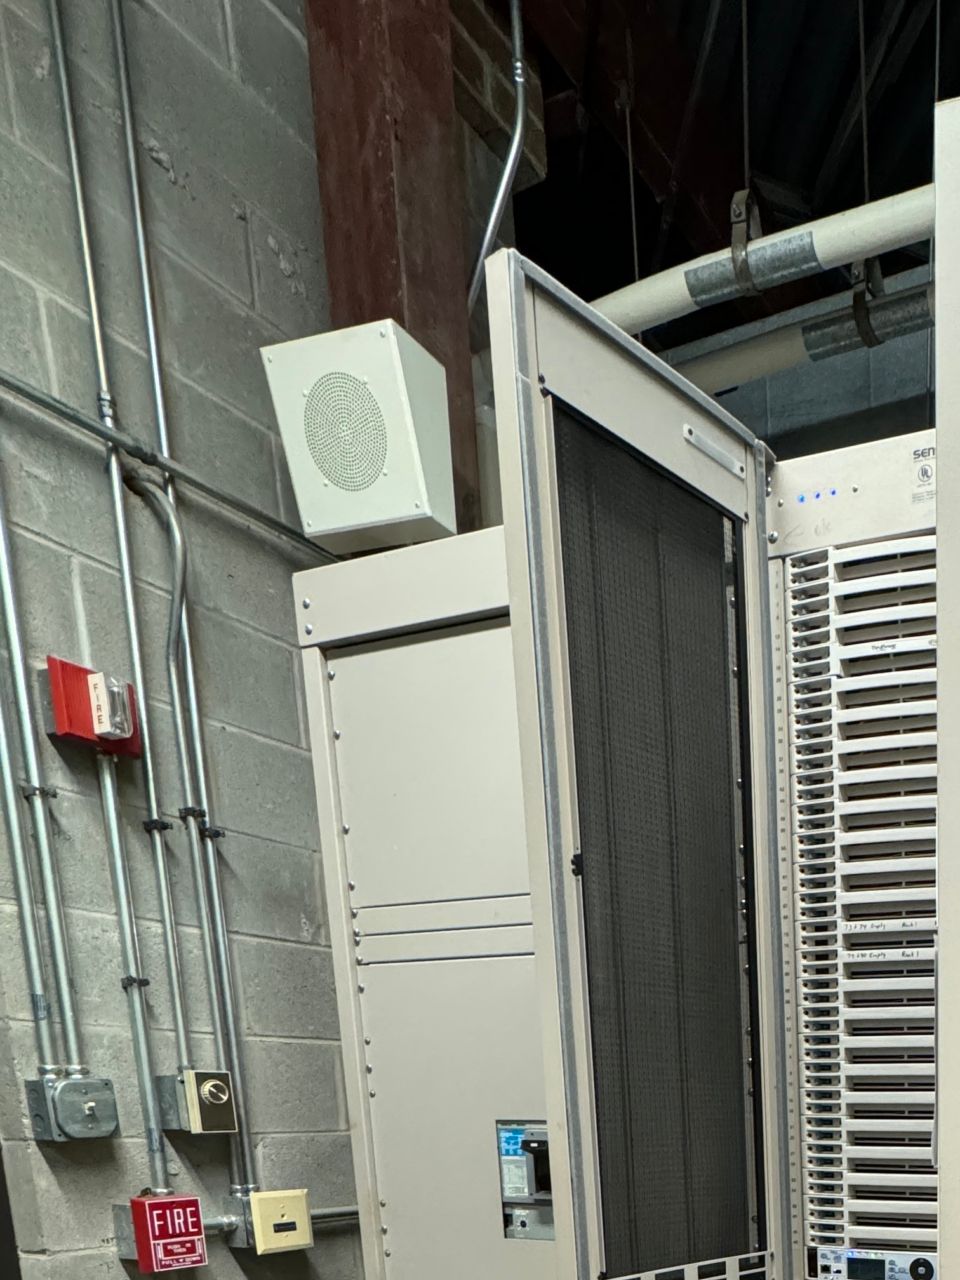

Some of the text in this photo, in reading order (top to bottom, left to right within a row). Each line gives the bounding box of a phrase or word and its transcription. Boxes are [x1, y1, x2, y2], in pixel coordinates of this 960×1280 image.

[93, 683, 104, 725] FIRE
[869, 951, 886, 960] Empty
[153, 1207, 199, 1236] FIRE
